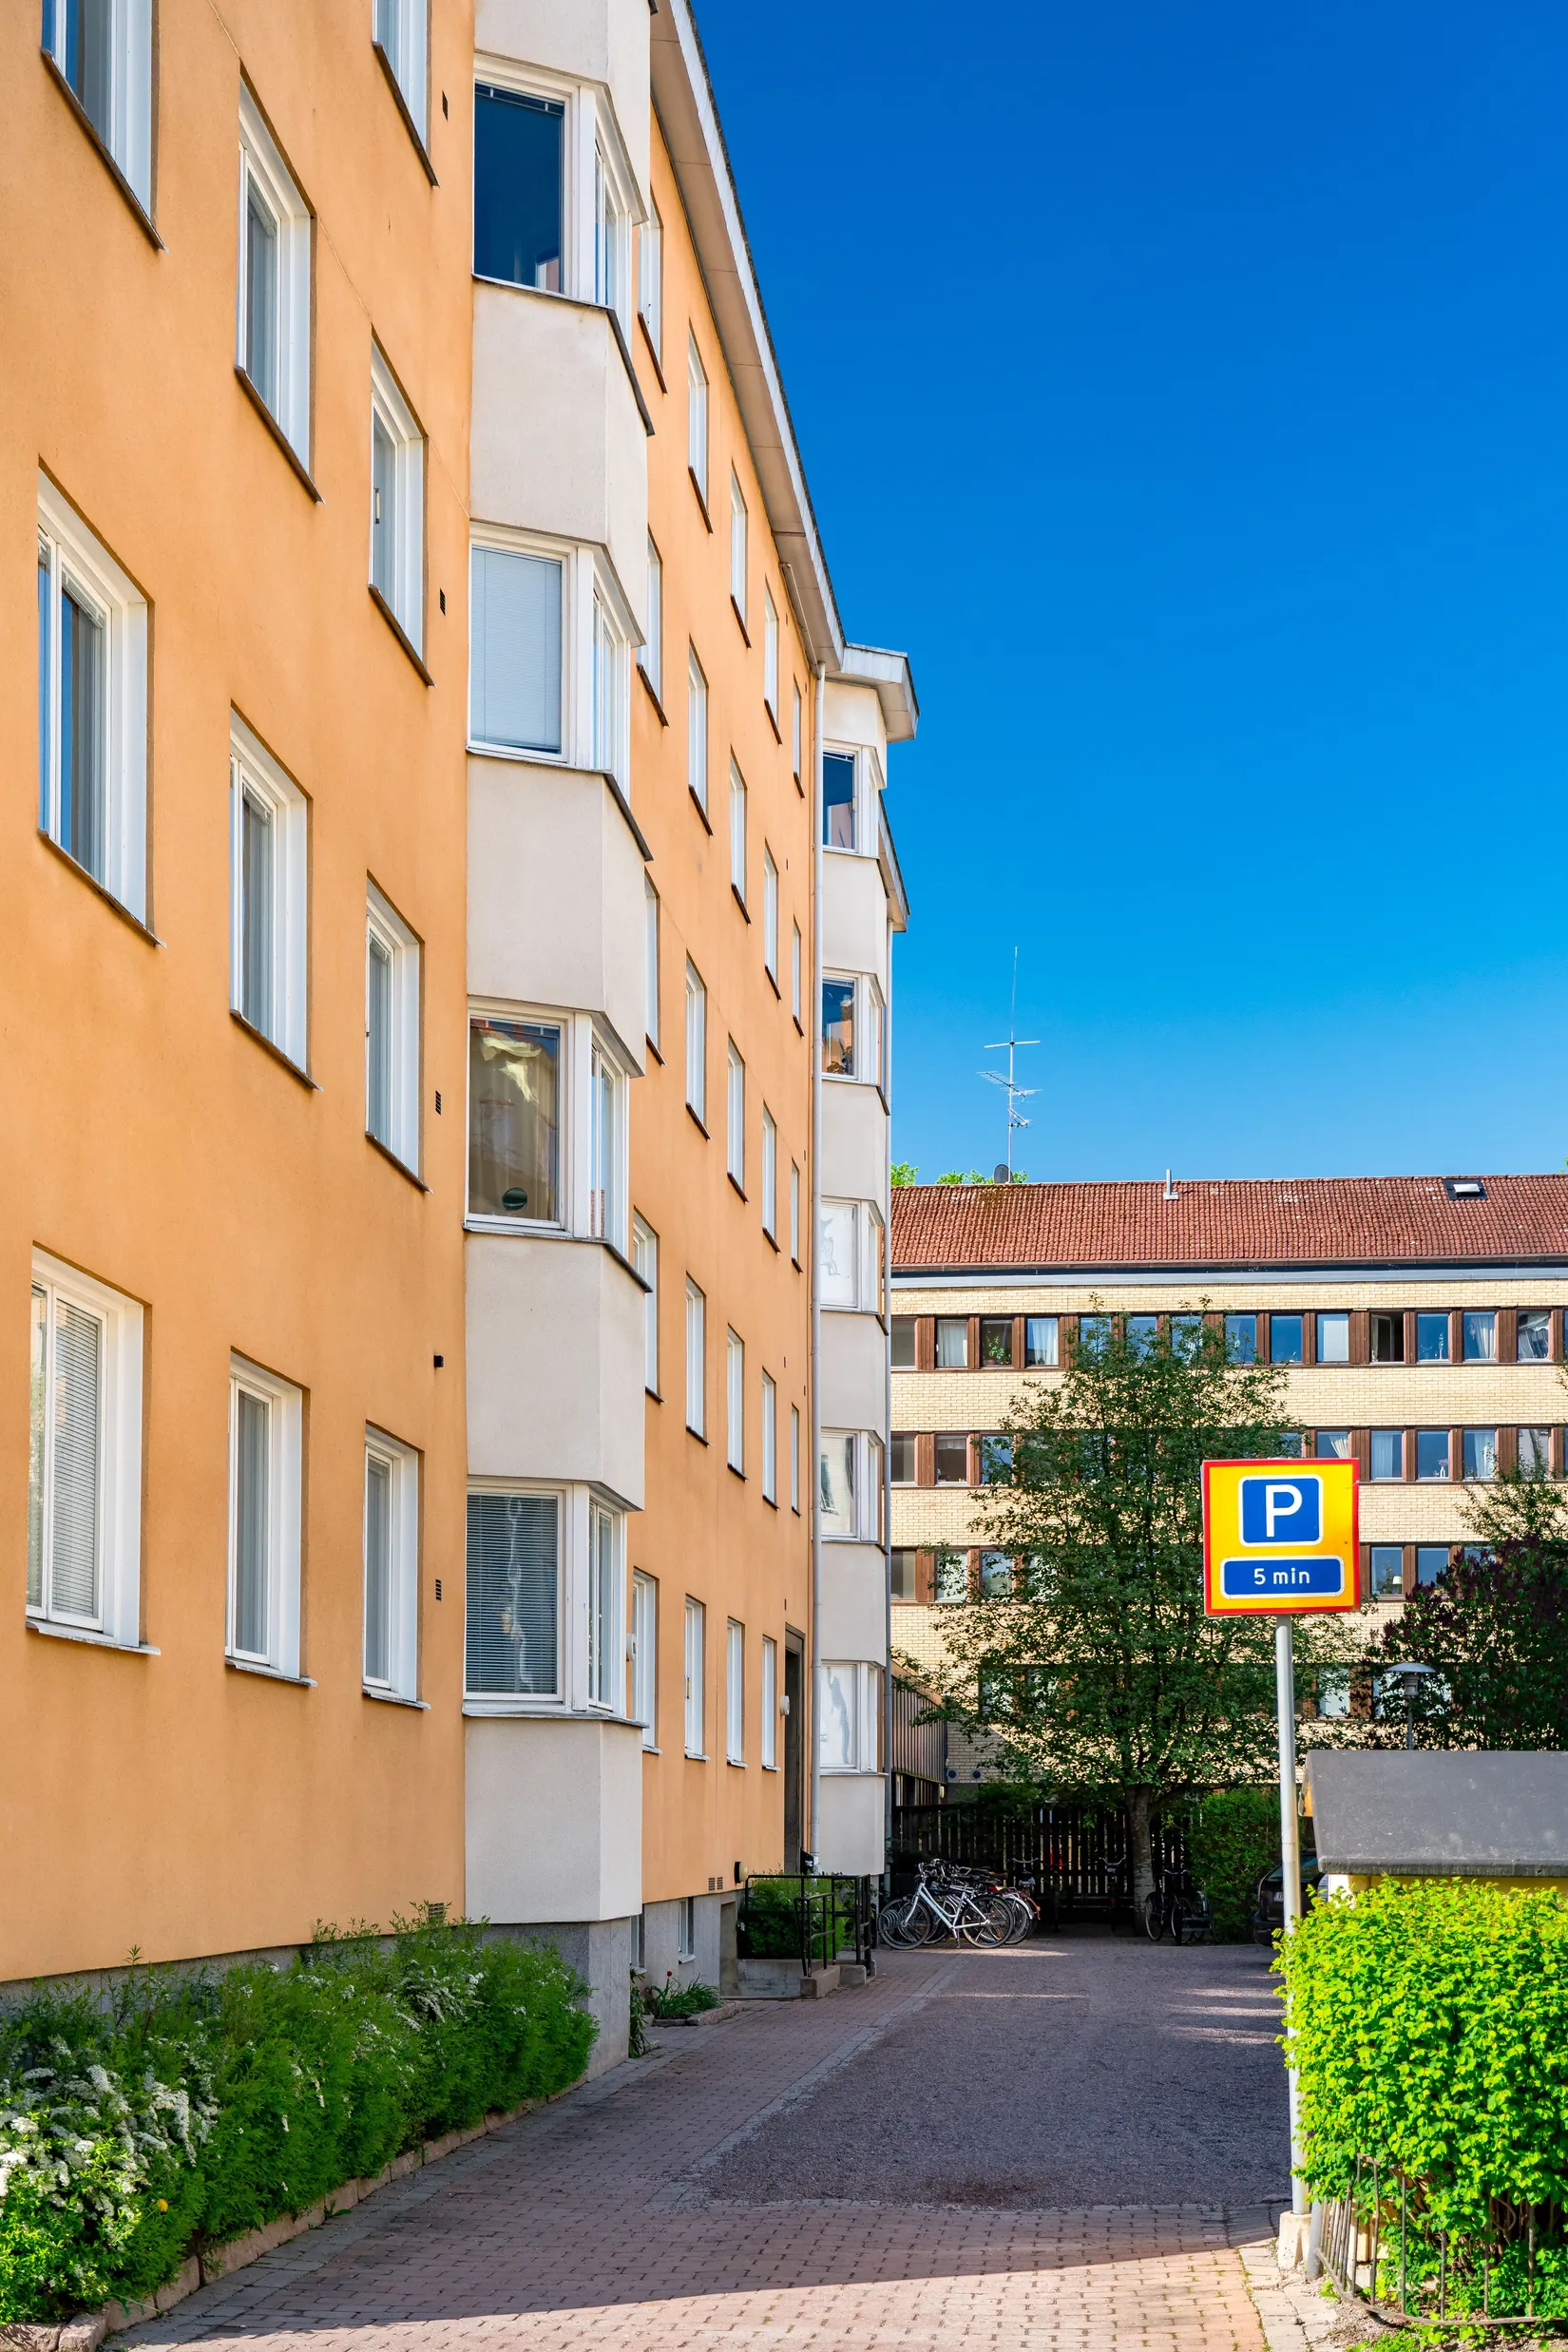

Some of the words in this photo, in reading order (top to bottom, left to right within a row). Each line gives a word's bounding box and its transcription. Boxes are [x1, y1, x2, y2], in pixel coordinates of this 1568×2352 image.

[1266, 1484, 1303, 1538] P
[1253, 1568, 1266, 1585] 5
[1272, 1567, 1310, 1585] min
